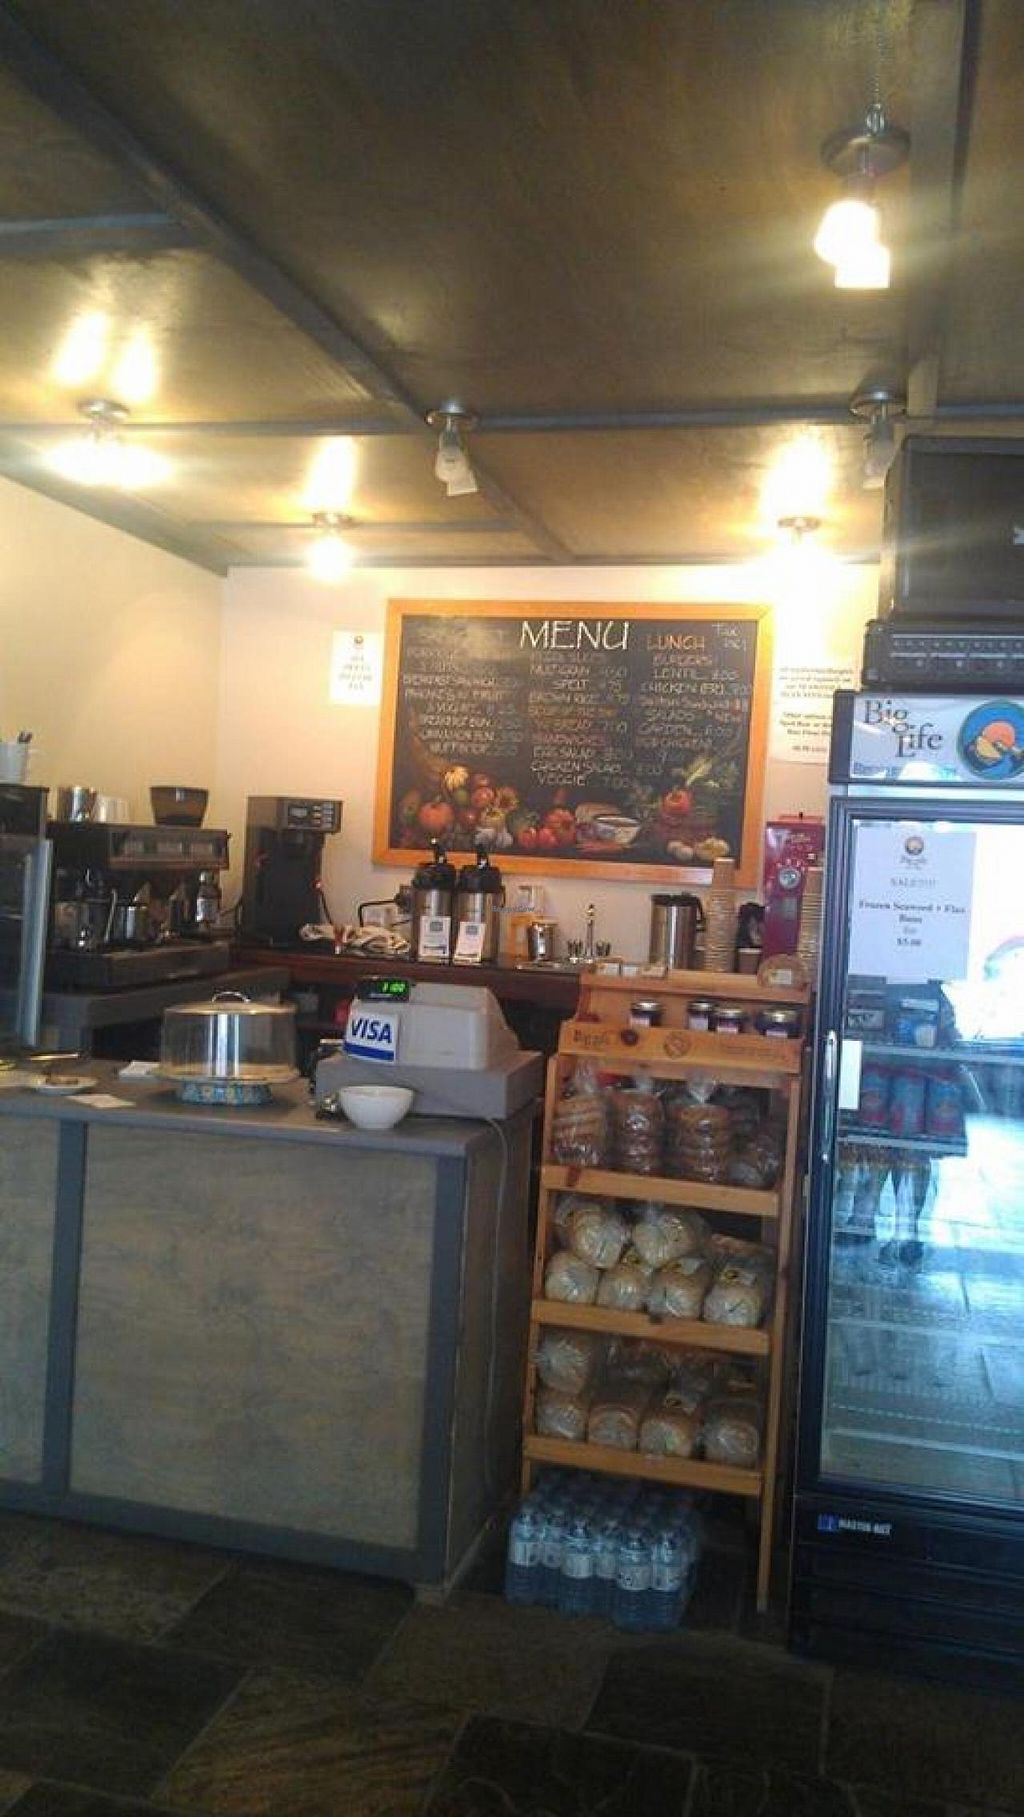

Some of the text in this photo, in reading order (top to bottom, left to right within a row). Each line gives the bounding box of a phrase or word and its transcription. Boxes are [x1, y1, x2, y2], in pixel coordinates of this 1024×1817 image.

[520, 620, 630, 650] MENU
[646, 634, 705, 651] LUNCH
[864, 699, 911, 733] Big
[895, 722, 943, 758] Life
[351, 1017, 393, 1044] VISA
